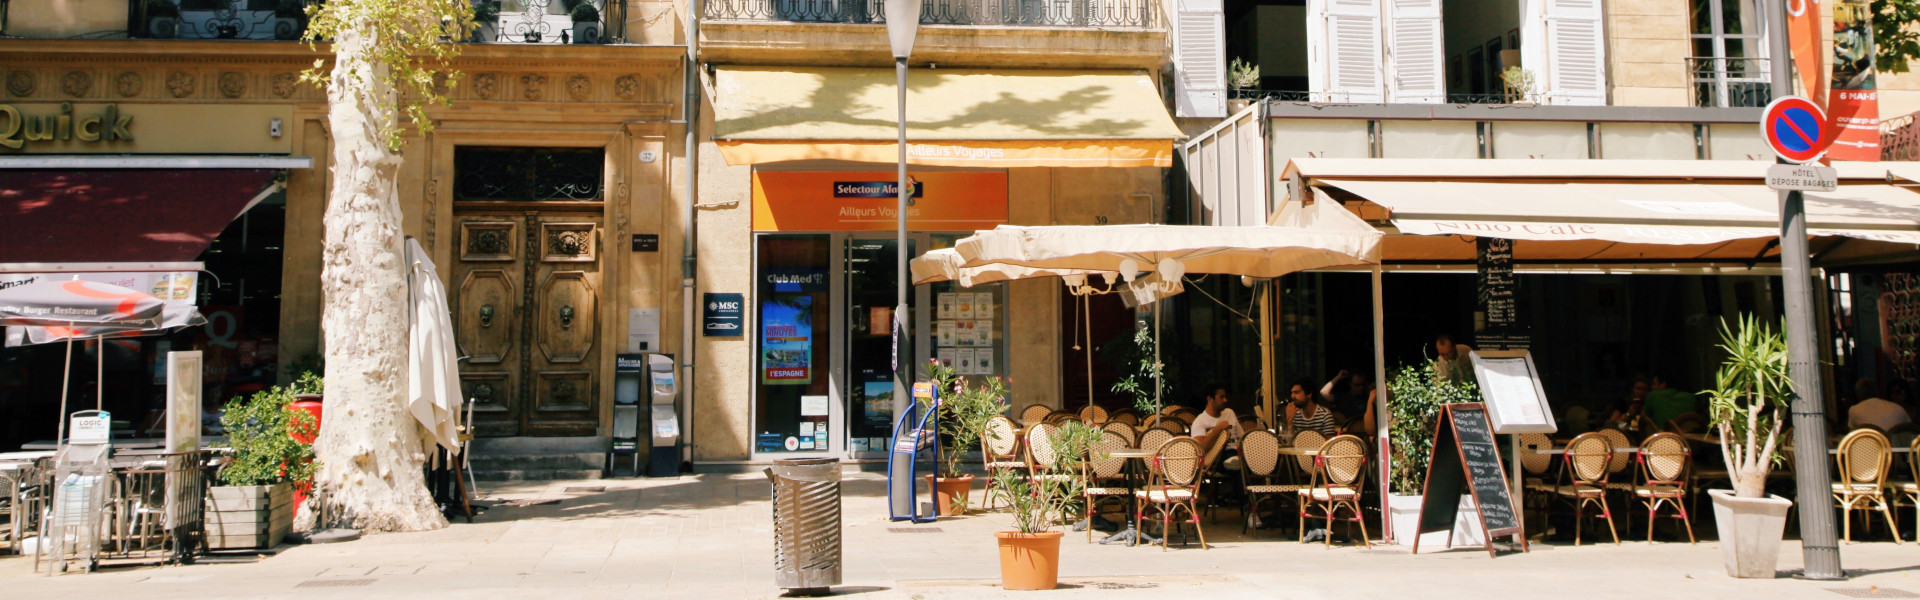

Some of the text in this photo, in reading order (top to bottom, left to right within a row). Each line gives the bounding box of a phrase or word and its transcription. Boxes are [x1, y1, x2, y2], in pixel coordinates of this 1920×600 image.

[0, 102, 134, 149] Quick
[906, 145, 1004, 160] Ailleurs Voyages
[1792, 168, 1814, 177] HÔTEL
[838, 184, 898, 194] Selectour Afa
[840, 206, 920, 218] Ailleurs Voyes
[1434, 222, 1512, 233] Nino
[767, 274, 811, 283] Club Med
[718, 301, 738, 310] MSC
[23, 306, 51, 316] Burger
[54, 307, 97, 315] Restaurant
